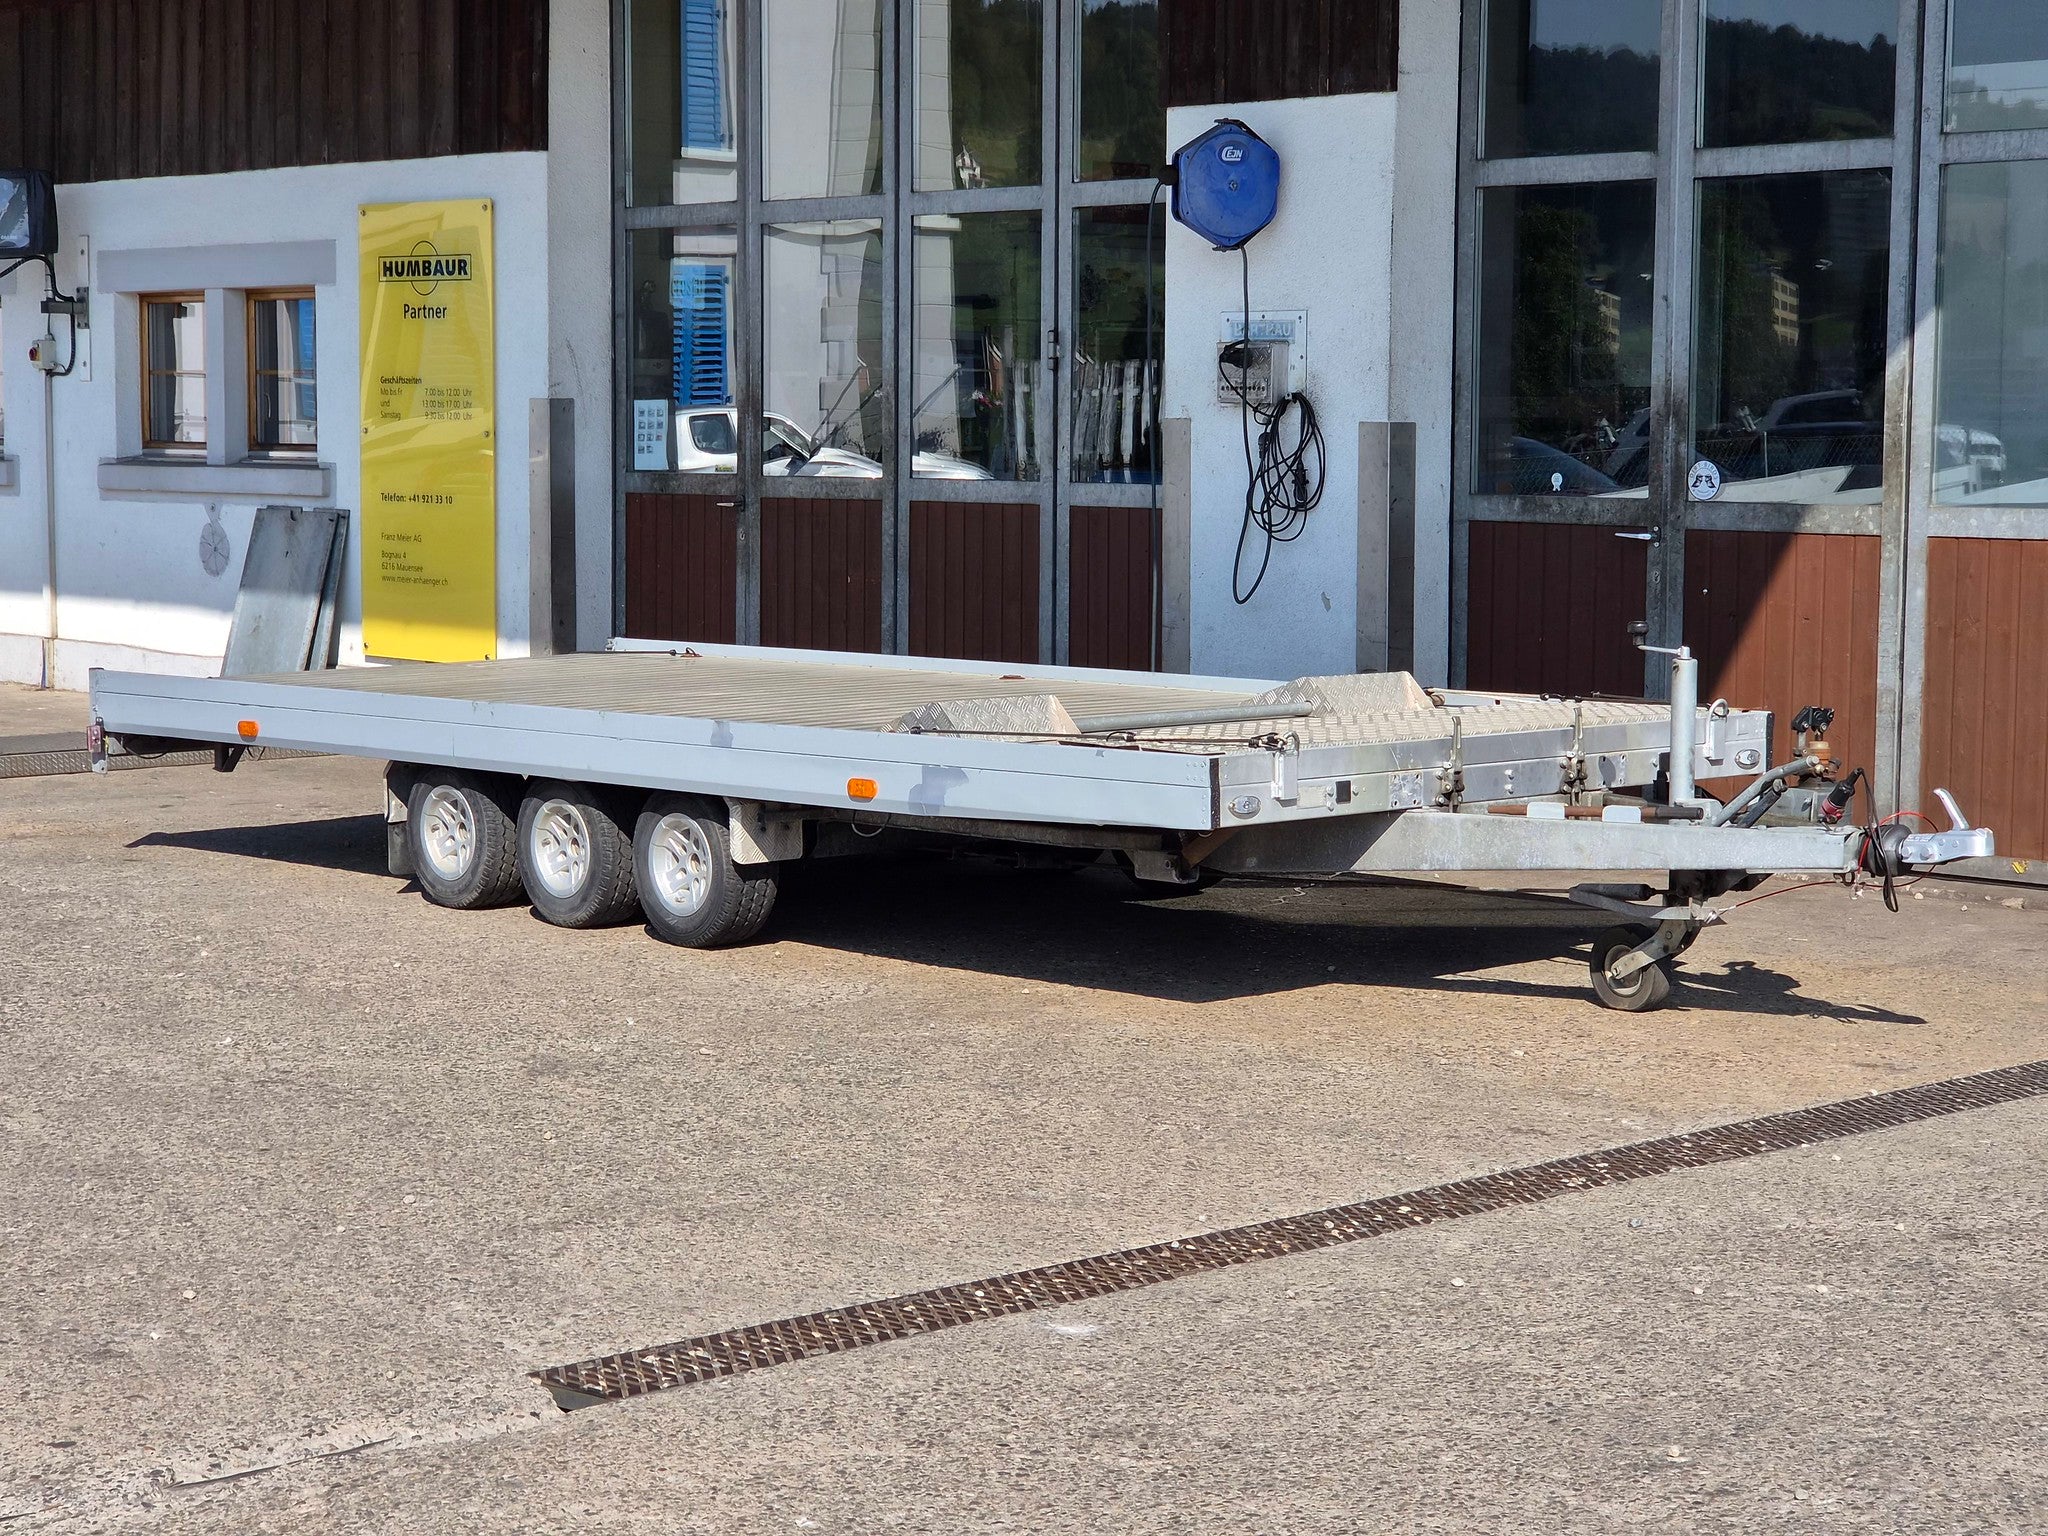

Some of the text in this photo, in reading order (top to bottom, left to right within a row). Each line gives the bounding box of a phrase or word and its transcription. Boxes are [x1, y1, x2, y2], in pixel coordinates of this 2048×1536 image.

[382, 259, 468, 277] HUMBAUR
[403, 303, 447, 319] Partner
[380, 376, 422, 385] Geschäftszeiten
[380, 387, 472, 397] Mo bis Fr 7.00 bis 12.00 Uhr
[437, 400, 445, 408] bis
[462, 401, 472, 409] Uhr
[380, 411, 401, 421] Samstag
[437, 411, 445, 420] bis
[462, 412, 472, 421] Uhr
[380, 492, 453, 505] Telefon: +41 921 33 10
[381, 532, 422, 543] Franz Meier AG
[381, 550, 407, 560] Bognau 4
[381, 561, 424, 573] 6216 Mauensee
